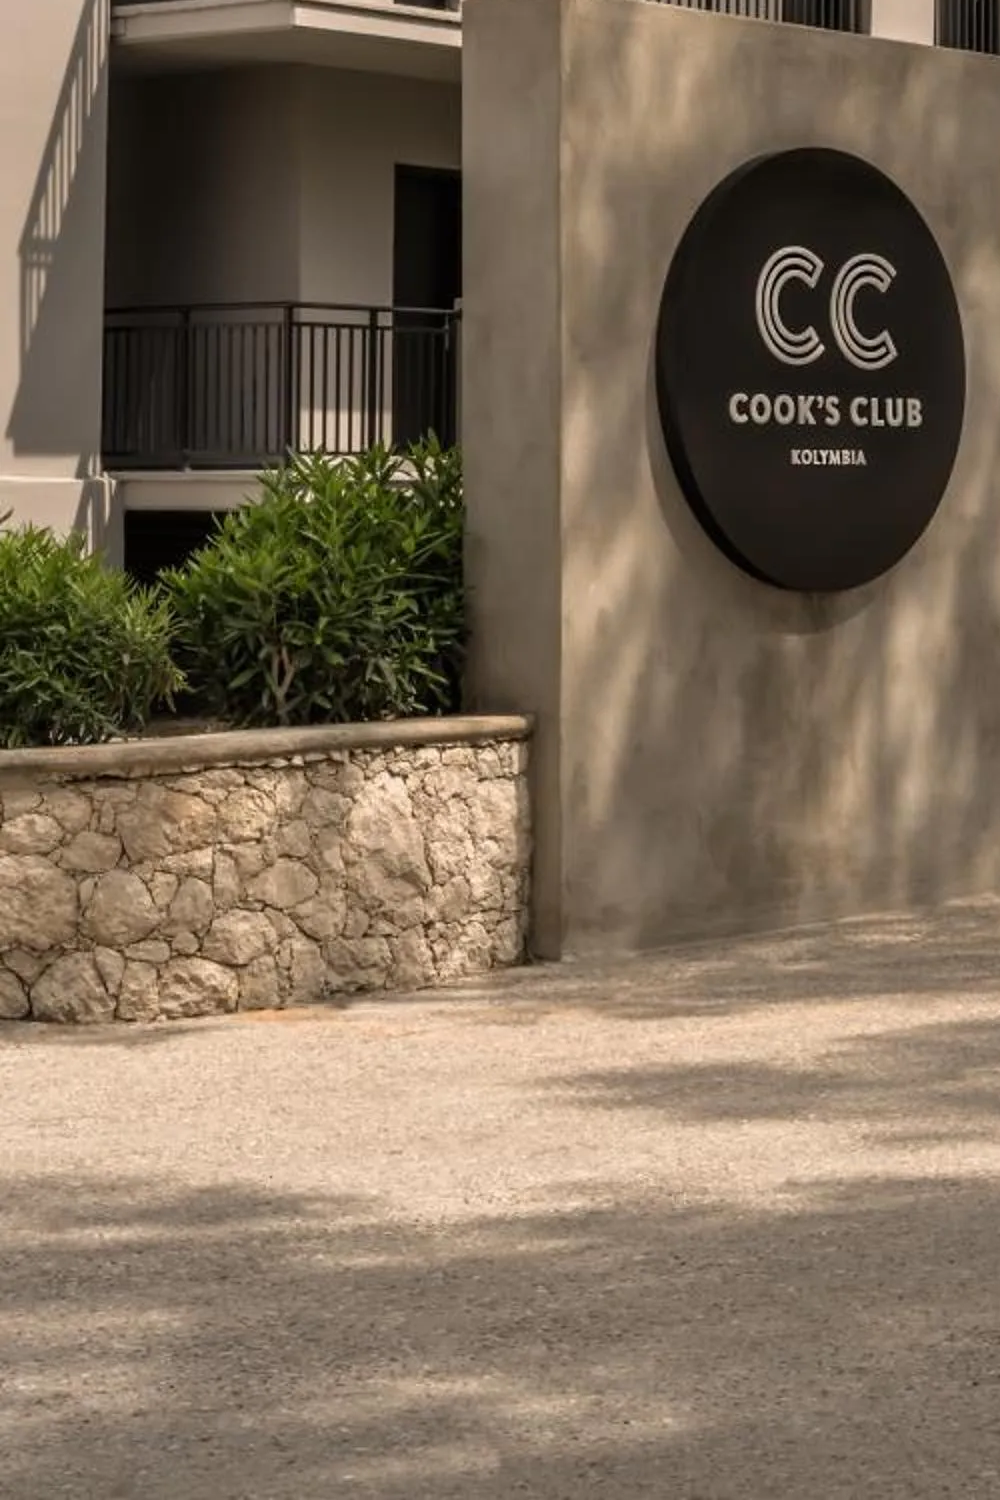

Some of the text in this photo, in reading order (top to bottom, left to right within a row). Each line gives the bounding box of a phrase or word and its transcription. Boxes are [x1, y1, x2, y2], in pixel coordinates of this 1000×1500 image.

[755, 245, 898, 370] CC
[729, 392, 923, 427] COOK'S CLUB
[790, 449, 867, 466] KOLYMBIA
